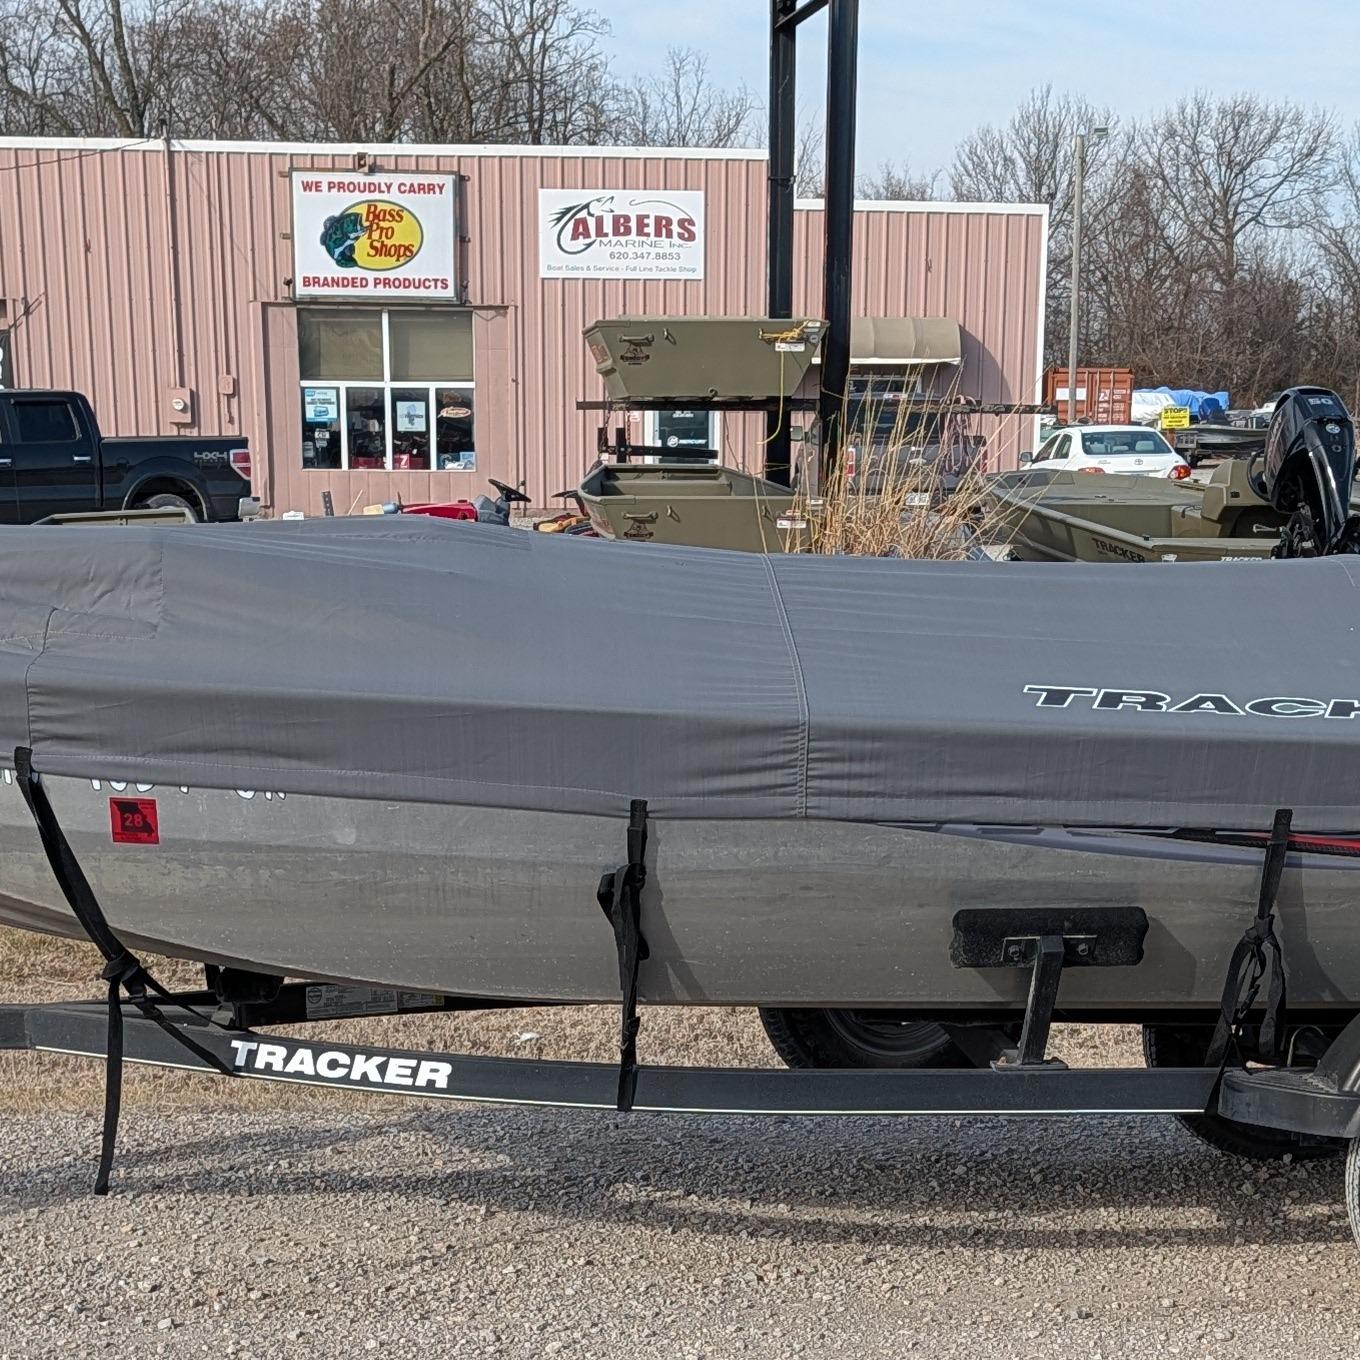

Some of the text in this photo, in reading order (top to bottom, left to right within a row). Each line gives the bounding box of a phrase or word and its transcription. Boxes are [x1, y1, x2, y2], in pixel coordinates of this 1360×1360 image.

[301, 180, 446, 195] WE PROUDLY CARRY
[365, 203, 404, 223] Bass
[366, 221, 395, 241] Pro
[570, 214, 697, 243] ALBERS
[367, 239, 415, 262] Shops
[599, 239, 664, 249] MARINE
[608, 251, 682, 261] 620.347.8853
[565, 264, 585, 272] Sales
[302, 276, 449, 290] BRANDED PRODUCTS
[1092, 538, 1146, 563] TRACKER
[123, 812, 145, 829] 28
[230, 1039, 453, 1089] TRACKER
